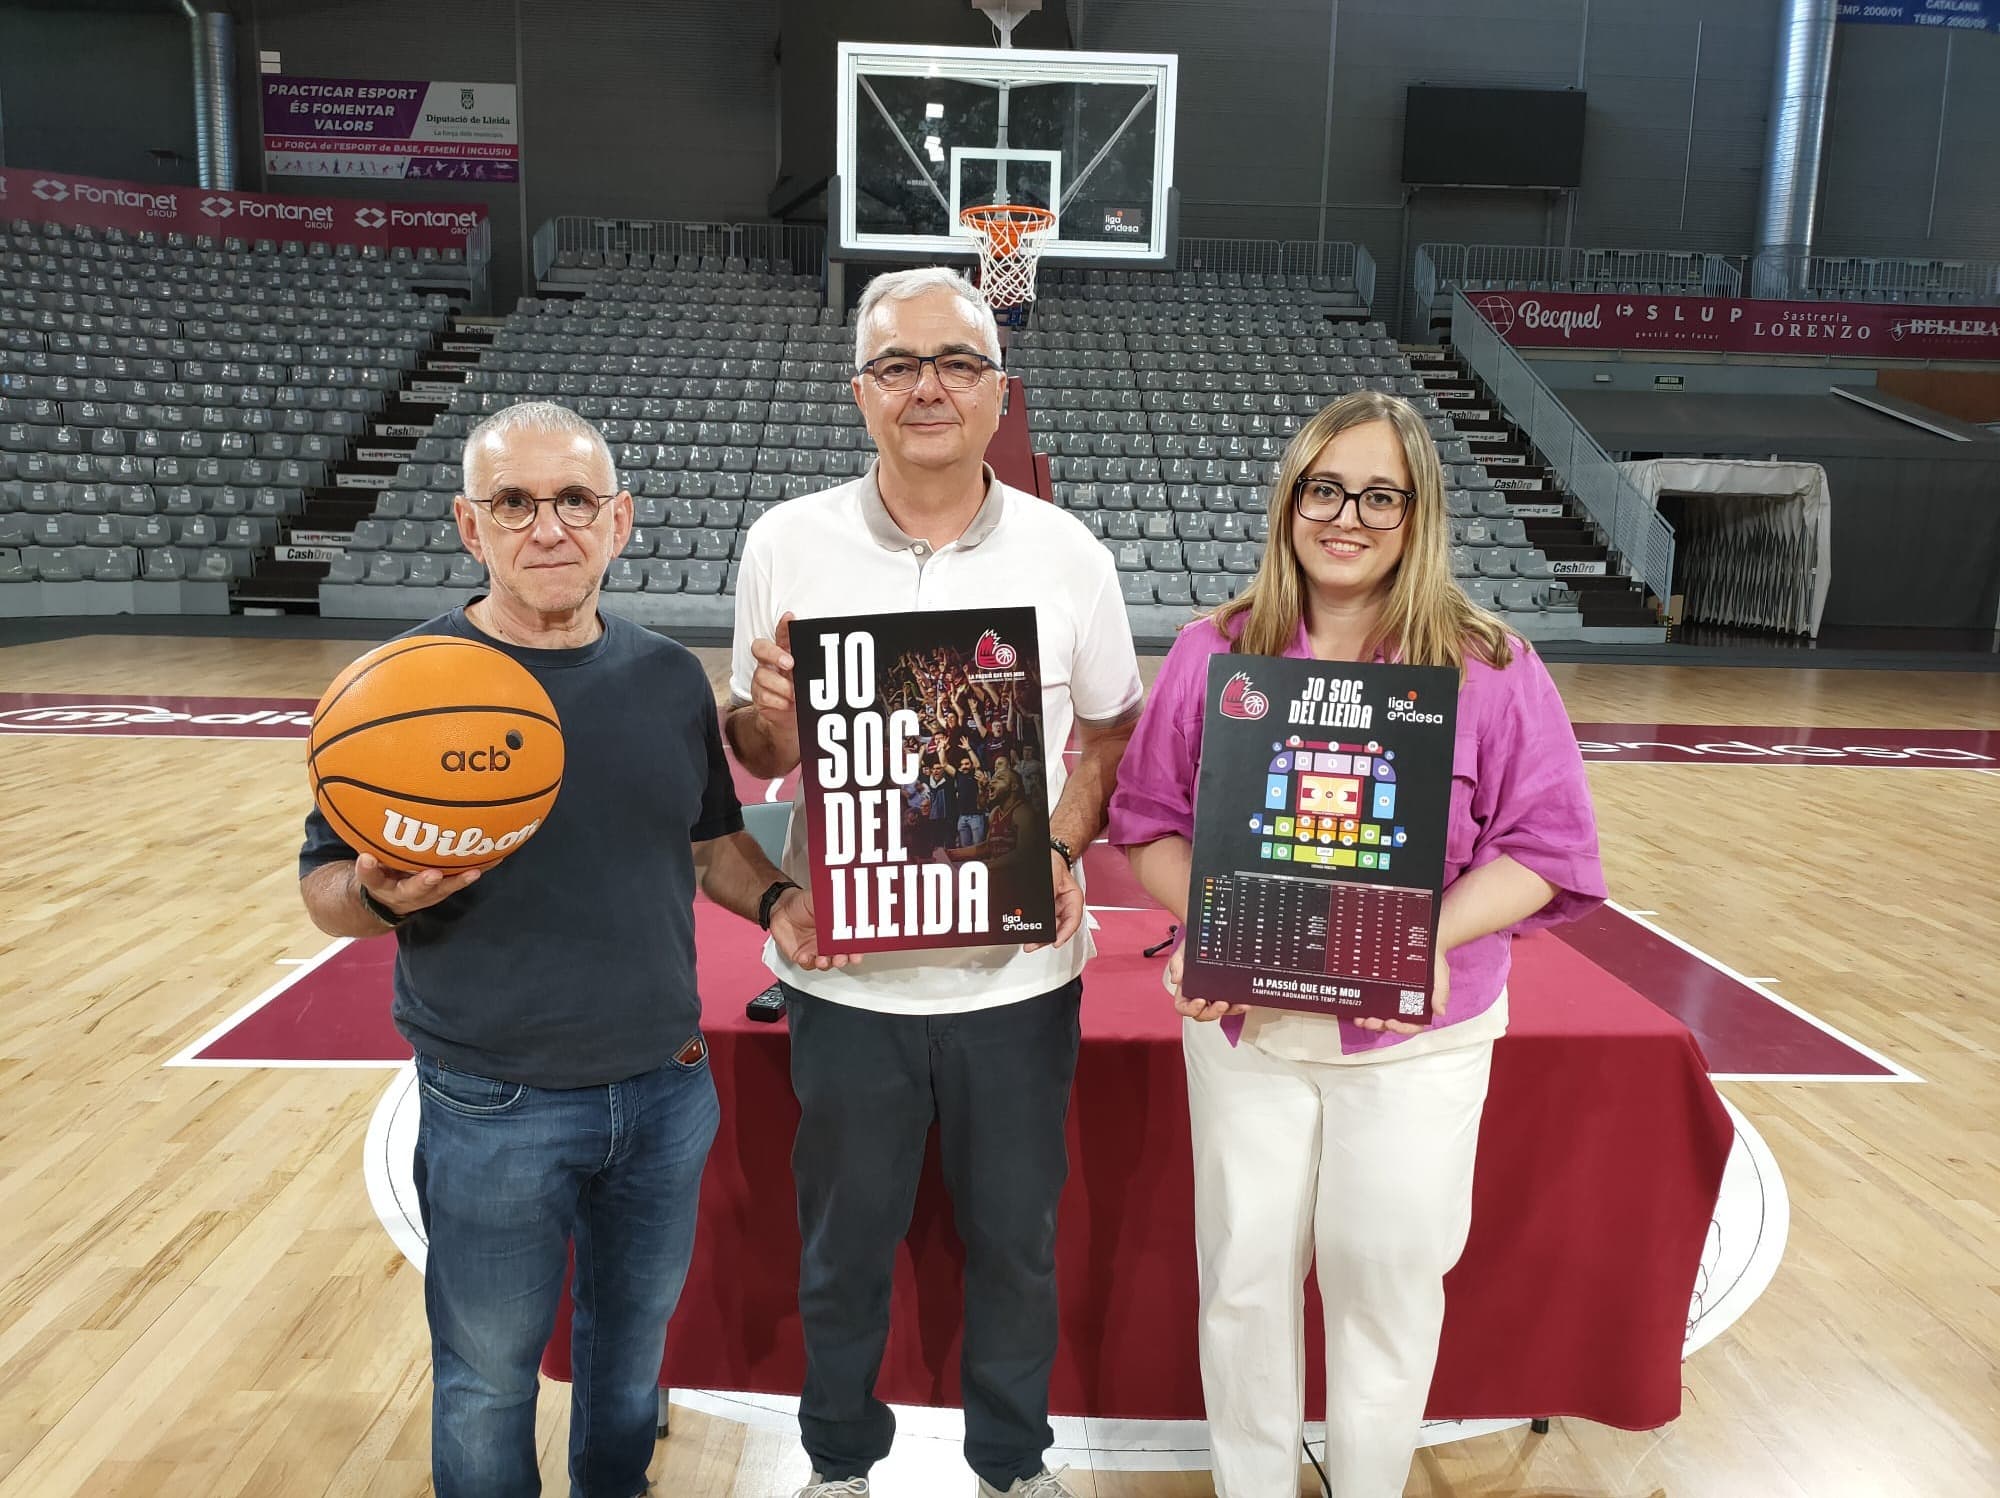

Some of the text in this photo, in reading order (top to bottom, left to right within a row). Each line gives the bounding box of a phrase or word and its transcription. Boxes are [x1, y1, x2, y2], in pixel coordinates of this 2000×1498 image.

[1836, 5, 1861, 16] EMP.
[268, 84, 418, 100] PRACTICAR ESPORT
[290, 101, 395, 116] ÉS FOMENTAR
[314, 119, 374, 132] VALORS
[426, 114, 511, 125] Diputació de Lleida
[271, 140, 283, 148] La
[285, 141, 317, 151] FORÇA
[319, 142, 332, 150] de
[394, 144, 421, 153] BASE,
[423, 145, 460, 154] FEMENÍ
[467, 147, 512, 156] INCLUSIU
[74, 184, 178, 210] Fontanet
[146, 209, 178, 218] GROUP
[239, 200, 334, 221] Fontanet
[391, 210, 478, 227] Fontanet
[304, 221, 334, 230] GROUP
[1518, 300, 1602, 338] Becquel
[1783, 311, 1848, 323] Sastreria
[1753, 322, 1871, 340] LORENZO
[1911, 319, 2000, 337] BELLERA
[1494, 479, 1533, 491] CashDro
[287, 547, 332, 560] CashDro
[1553, 562, 1596, 574] CashDro
[809, 631, 876, 710] JO
[1302, 677, 1364, 704] JO SOC
[1388, 696, 1414, 711] liga
[1287, 700, 1373, 729] DEL LLEIDA
[1387, 710, 1443, 725] endesa
[817, 709, 920, 789] SOC
[441, 745, 511, 772] acb
[383, 807, 540, 857] Wilson
[824, 789, 907, 866] DEL
[831, 861, 990, 941] LLEIDA
[1002, 912, 1021, 924] liga
[1003, 919, 1042, 931] endesa
[1252, 977, 1361, 999] LA PASSIÓ QUE ENS MOU
[1252, 988, 1281, 997] CAMPANYA
